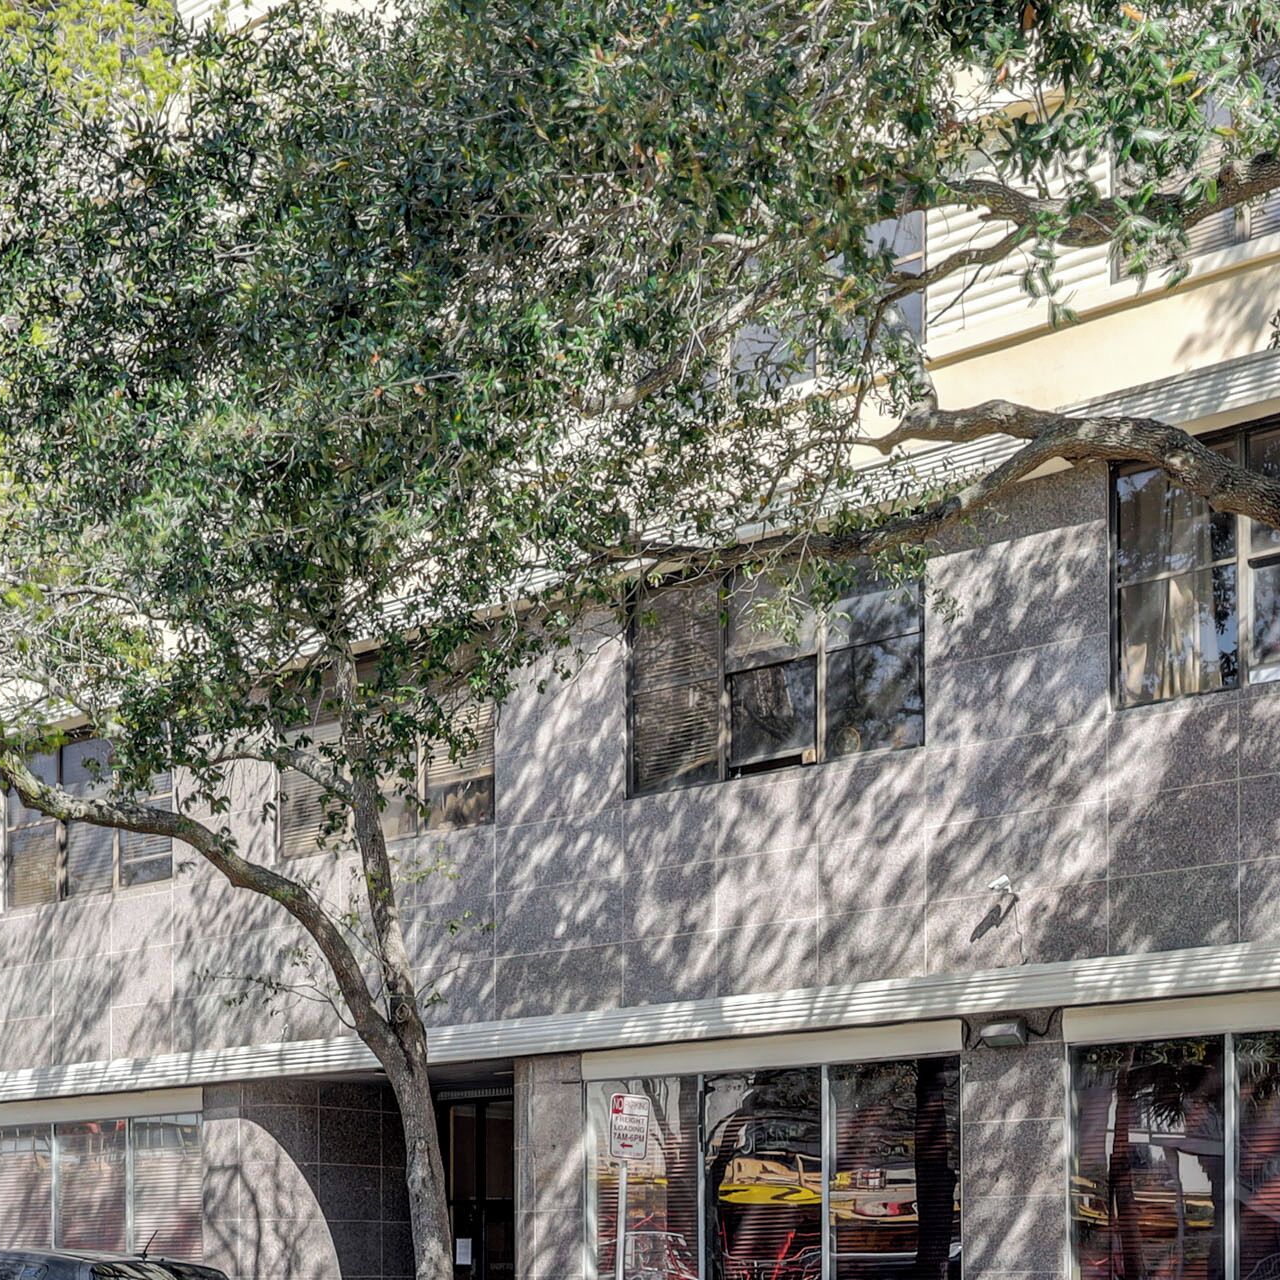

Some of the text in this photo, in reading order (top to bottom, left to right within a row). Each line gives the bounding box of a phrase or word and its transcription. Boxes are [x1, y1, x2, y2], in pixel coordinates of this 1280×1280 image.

[612, 1096, 624, 1110] NO
[615, 1116, 646, 1125] FREIGHT
[613, 1124, 645, 1133] LOADING
[613, 1132, 645, 1142] 7AM-6PM
